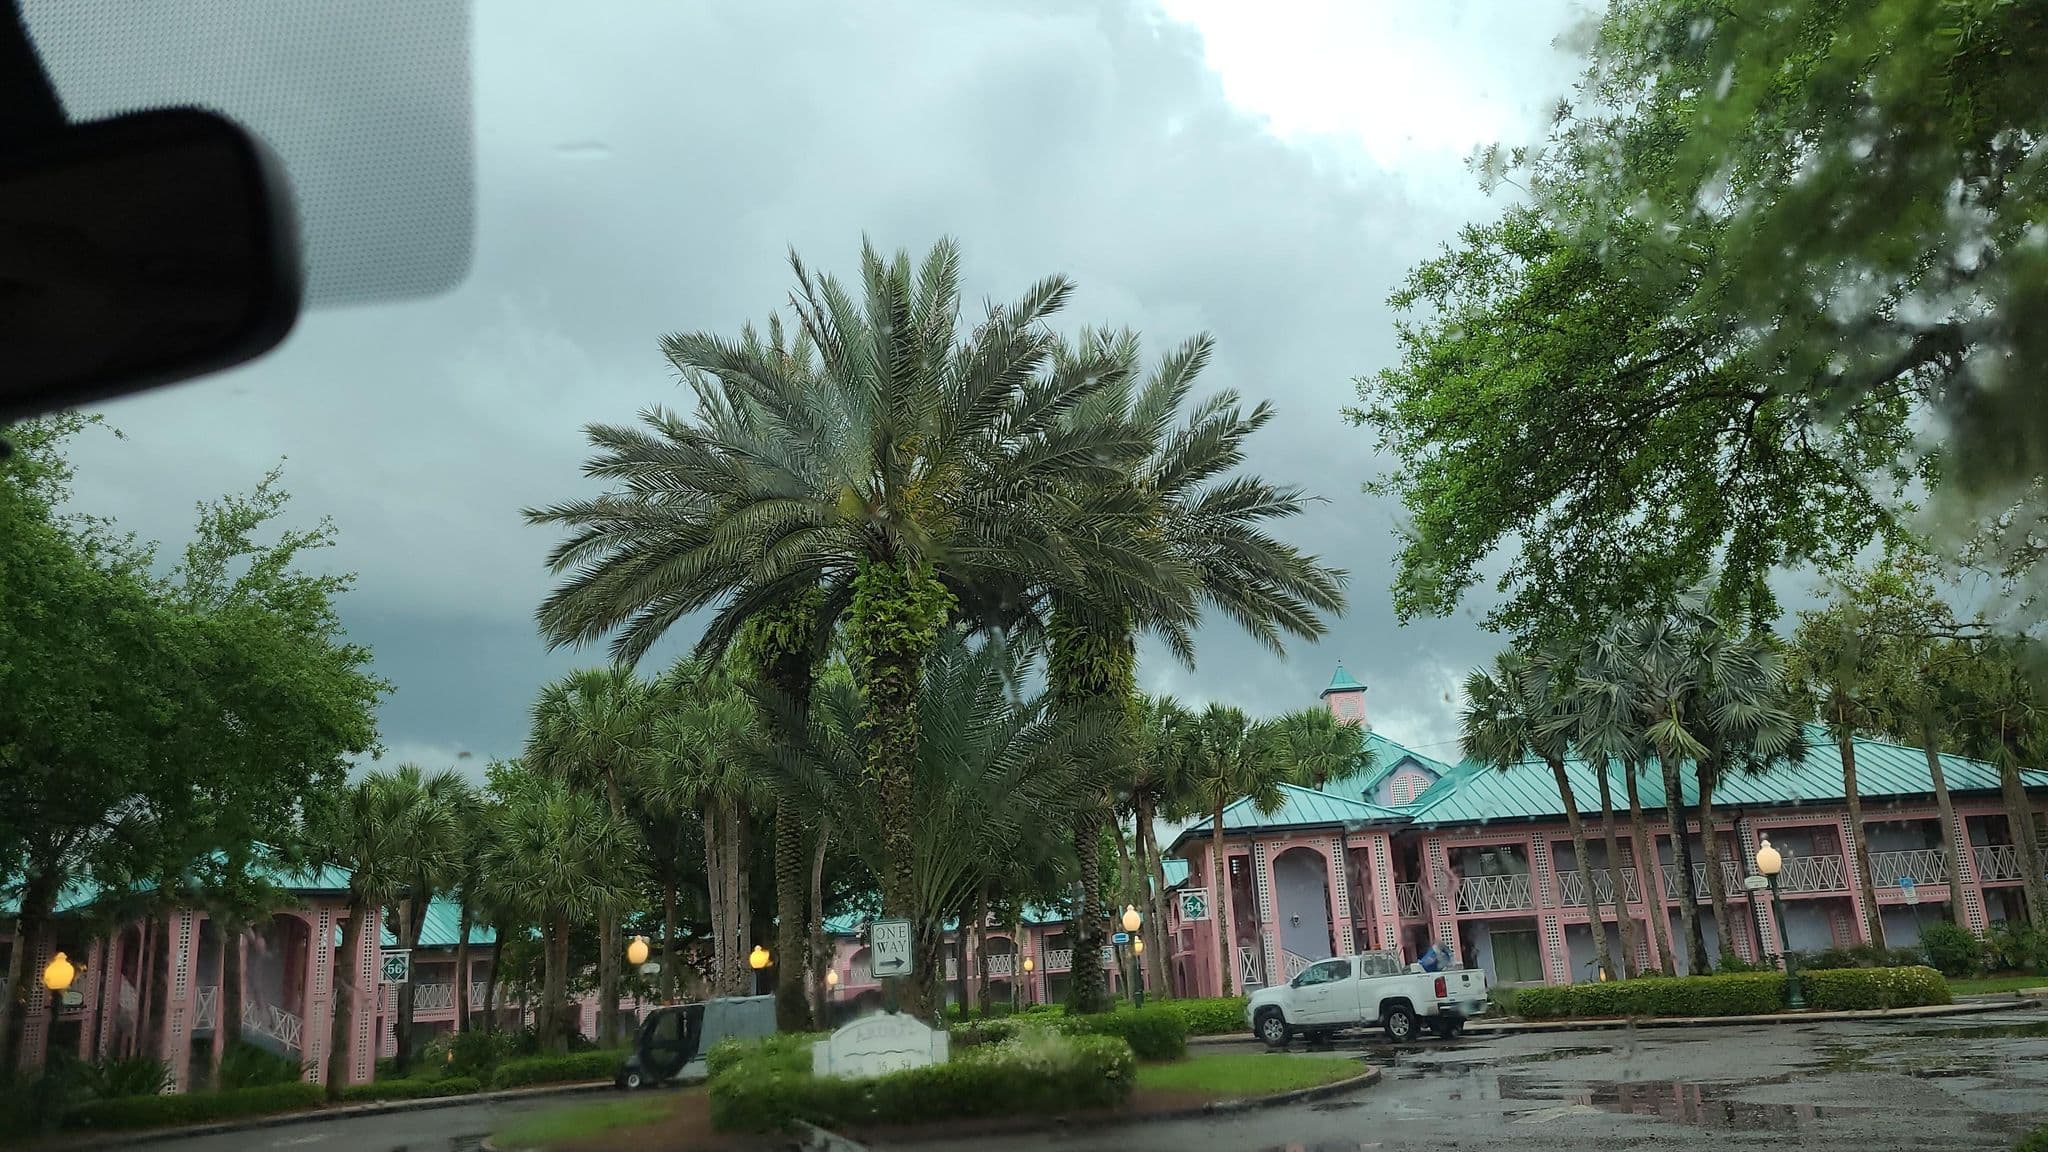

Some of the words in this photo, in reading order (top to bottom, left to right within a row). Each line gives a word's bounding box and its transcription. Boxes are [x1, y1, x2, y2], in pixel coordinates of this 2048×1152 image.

[1187, 902, 1201, 912] 54
[876, 926, 906, 939] ONE
[877, 940, 907, 953] WAY
[388, 963, 402, 974] 56
